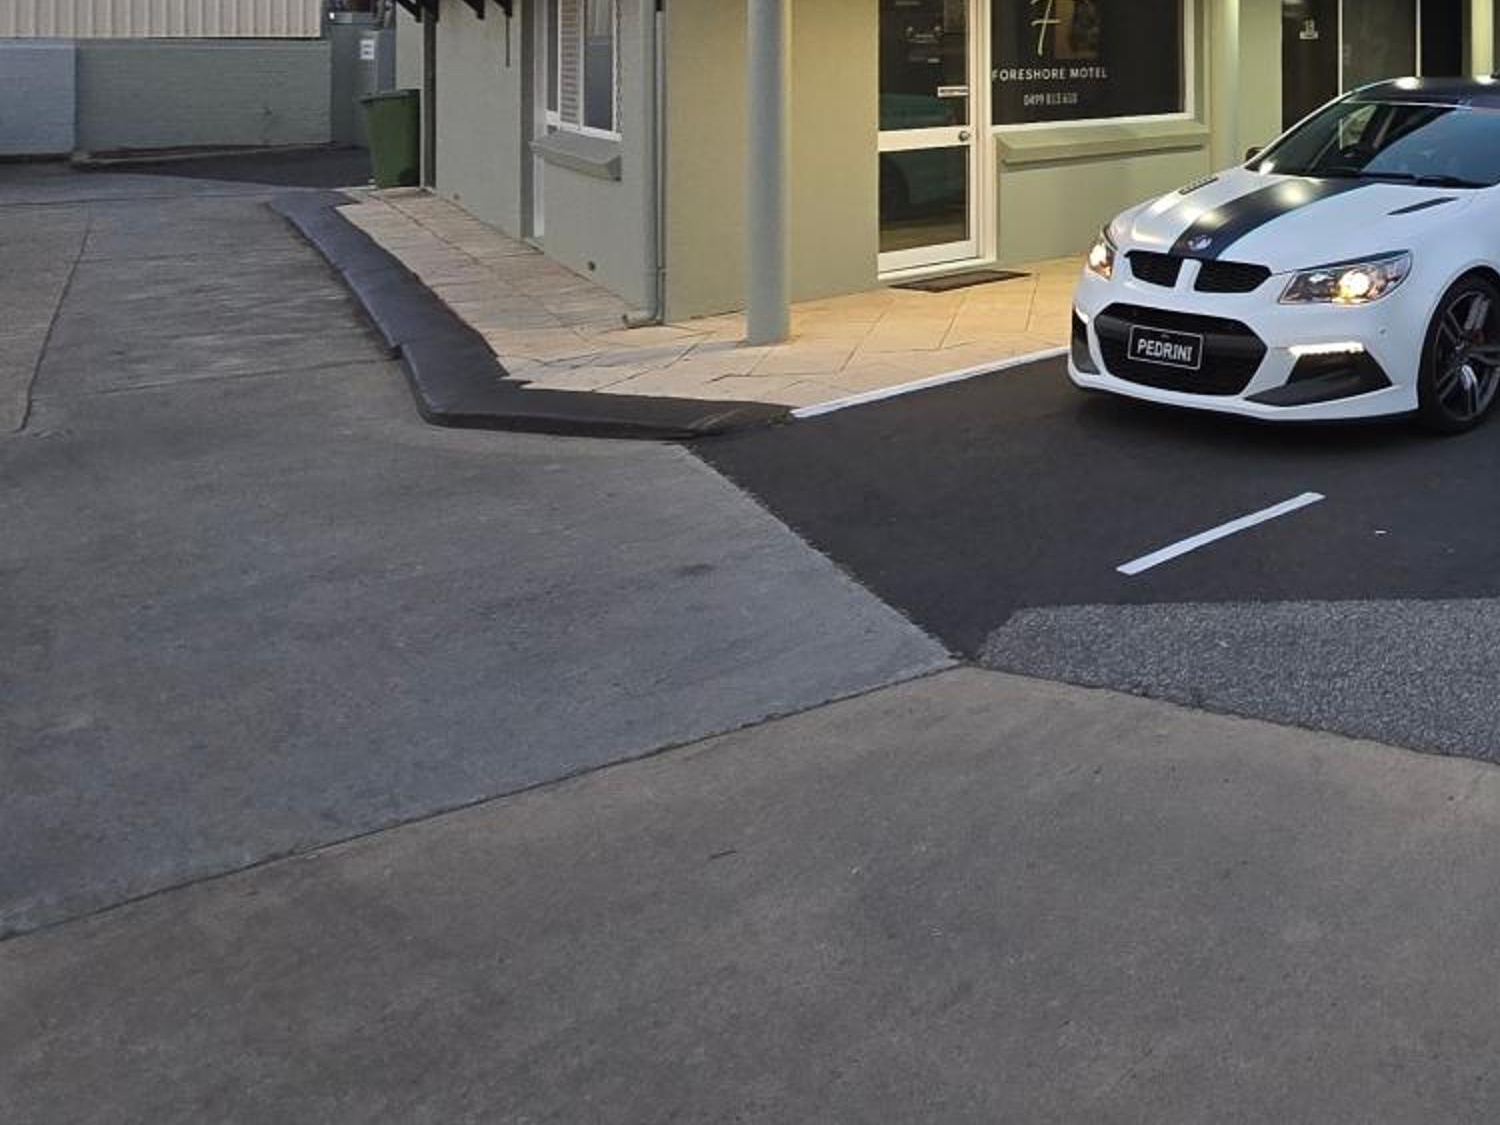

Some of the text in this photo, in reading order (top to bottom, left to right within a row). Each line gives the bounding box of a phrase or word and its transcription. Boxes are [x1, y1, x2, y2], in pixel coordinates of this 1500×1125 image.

[992, 66, 1108, 81] FORESHORE MOTEL
[1137, 338, 1193, 362] PEDRINI
